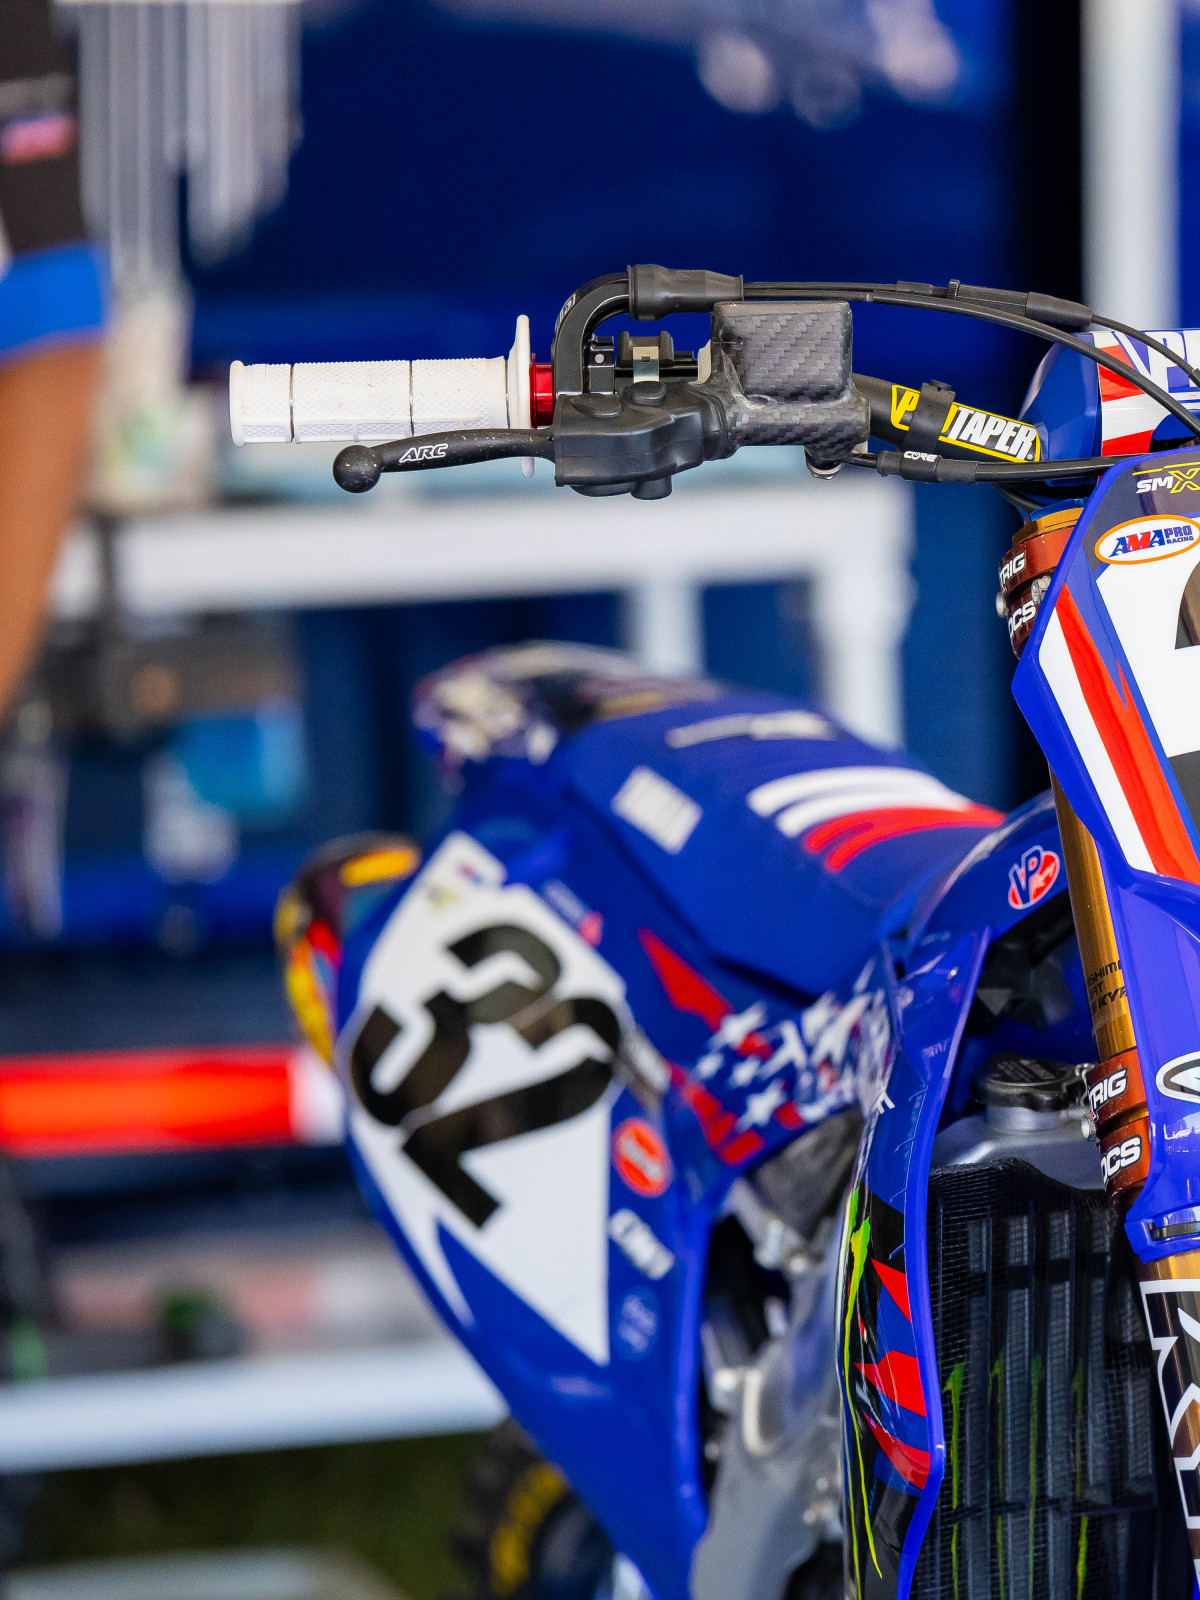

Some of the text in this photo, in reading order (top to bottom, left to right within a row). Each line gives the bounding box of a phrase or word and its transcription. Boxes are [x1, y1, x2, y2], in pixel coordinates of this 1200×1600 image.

[948, 406, 1037, 460] TAPER
[399, 443, 449, 463] ARC
[903, 450, 938, 463] CORE
[1109, 525, 1192, 557] AMA PRO
[1166, 536, 1194, 545] RACING
[1008, 845, 1048, 909] VP
[351, 924, 622, 1230] 32
